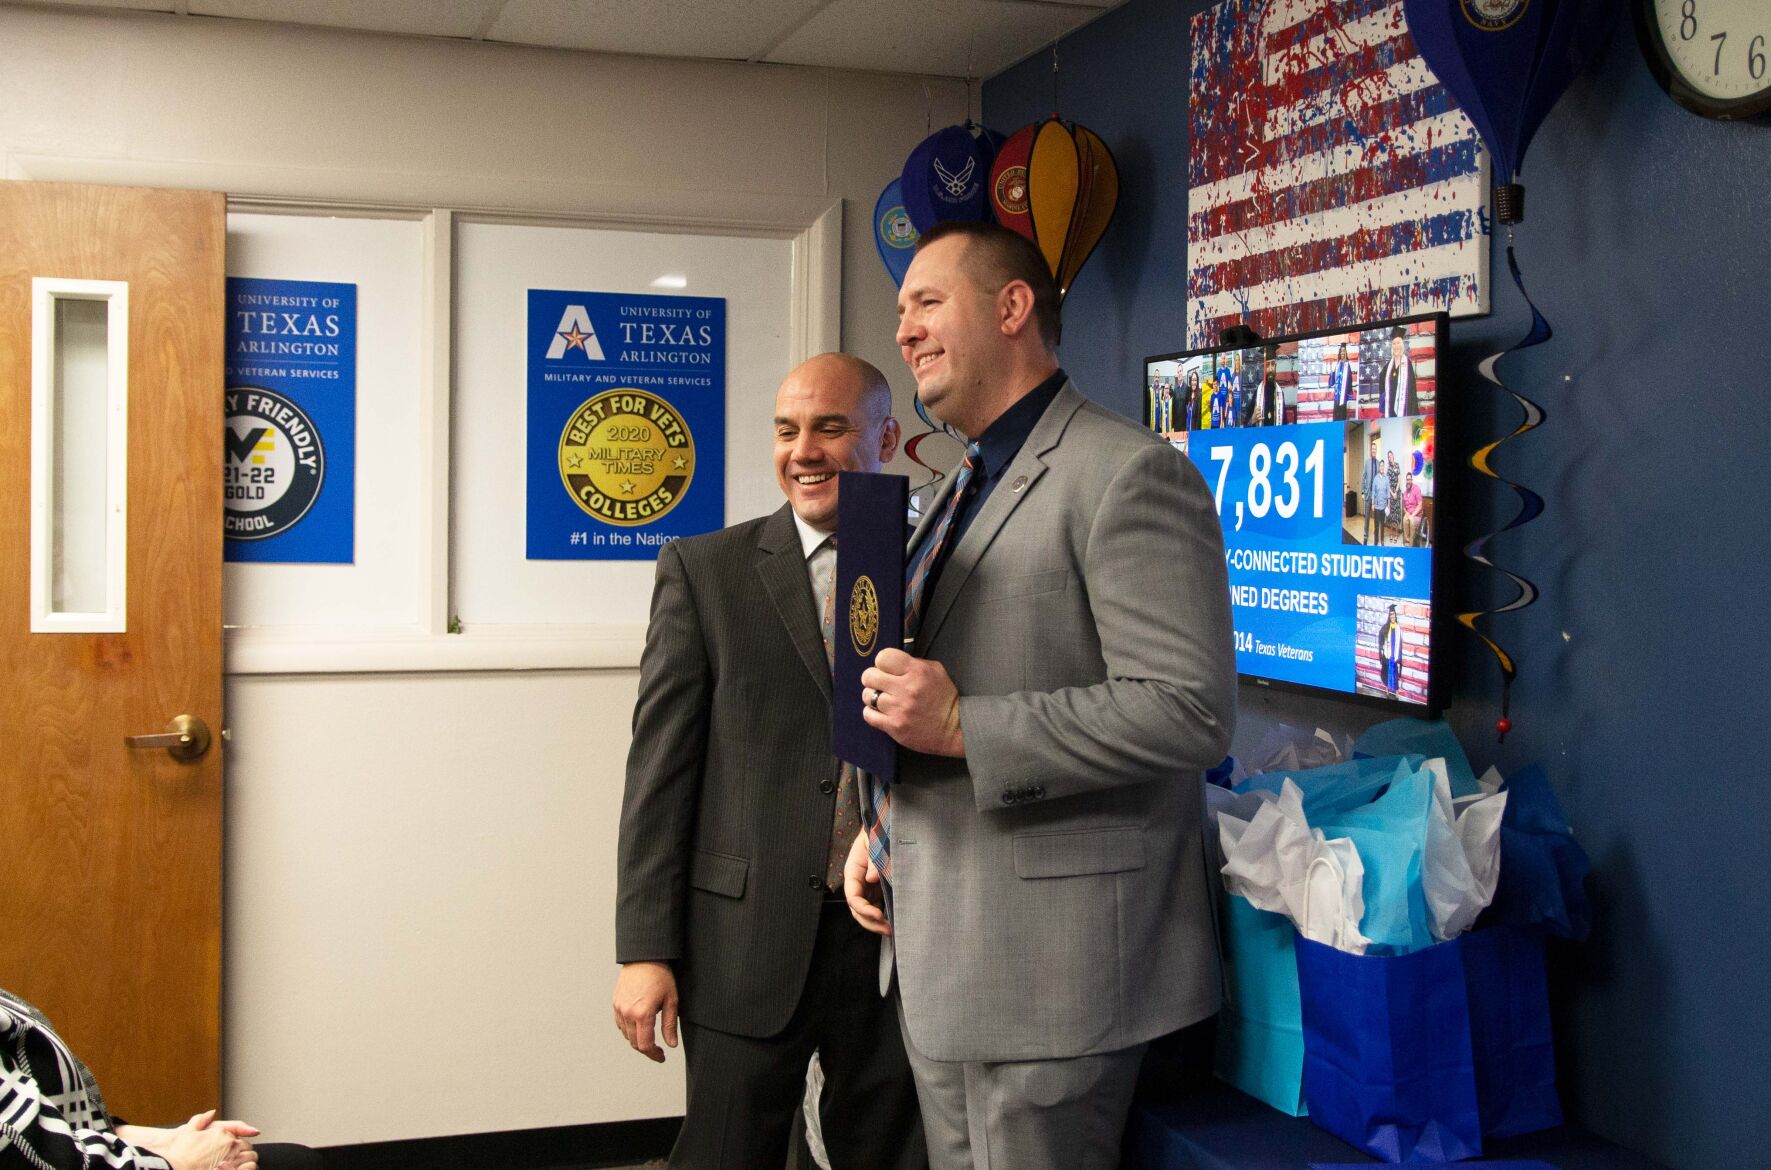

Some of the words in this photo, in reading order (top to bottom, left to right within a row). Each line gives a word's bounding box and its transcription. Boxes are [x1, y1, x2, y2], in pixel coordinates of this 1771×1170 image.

[1681, 0, 1697, 41] 8
[1711, 32, 1727, 76] 7
[1748, 35, 1766, 80] 6
[238, 294, 318, 308] UNIVERSITY
[322, 297, 340, 308] OF
[620, 306, 692, 319] UNIVERSITY
[696, 309, 712, 319] OF
[237, 311, 340, 337] TEXAS
[619, 322, 712, 346] TEXAS
[237, 341, 339, 356] ARLINGTON
[619, 350, 711, 364] ARLINGTON
[237, 369, 286, 378] VETERAN
[290, 369, 339, 379] SERVICES
[544, 373, 592, 382] MILITARY
[595, 375, 617, 383] AND
[620, 376, 664, 385] VETERAN
[667, 377, 711, 386] SERVICES
[569, 403, 604, 444] BEST
[610, 396, 646, 414] FOR
[651, 407, 686, 447] VETS
[607, 426, 651, 442] 2020
[587, 447, 666, 462] MILITARY
[602, 461, 654, 475] TIMES
[225, 486, 265, 500] GOLD
[1210, 439, 1326, 533] 7,831
[580, 484, 673, 519] COLLEGES
[570, 532, 588, 545] #1
[593, 532, 605, 545] in
[609, 533, 631, 546] the
[1320, 554, 1406, 582] STUDENTS
[1261, 588, 1329, 615] DEGREES
[1255, 640, 1276, 657] Texas
[1278, 643, 1314, 662] Veterans
